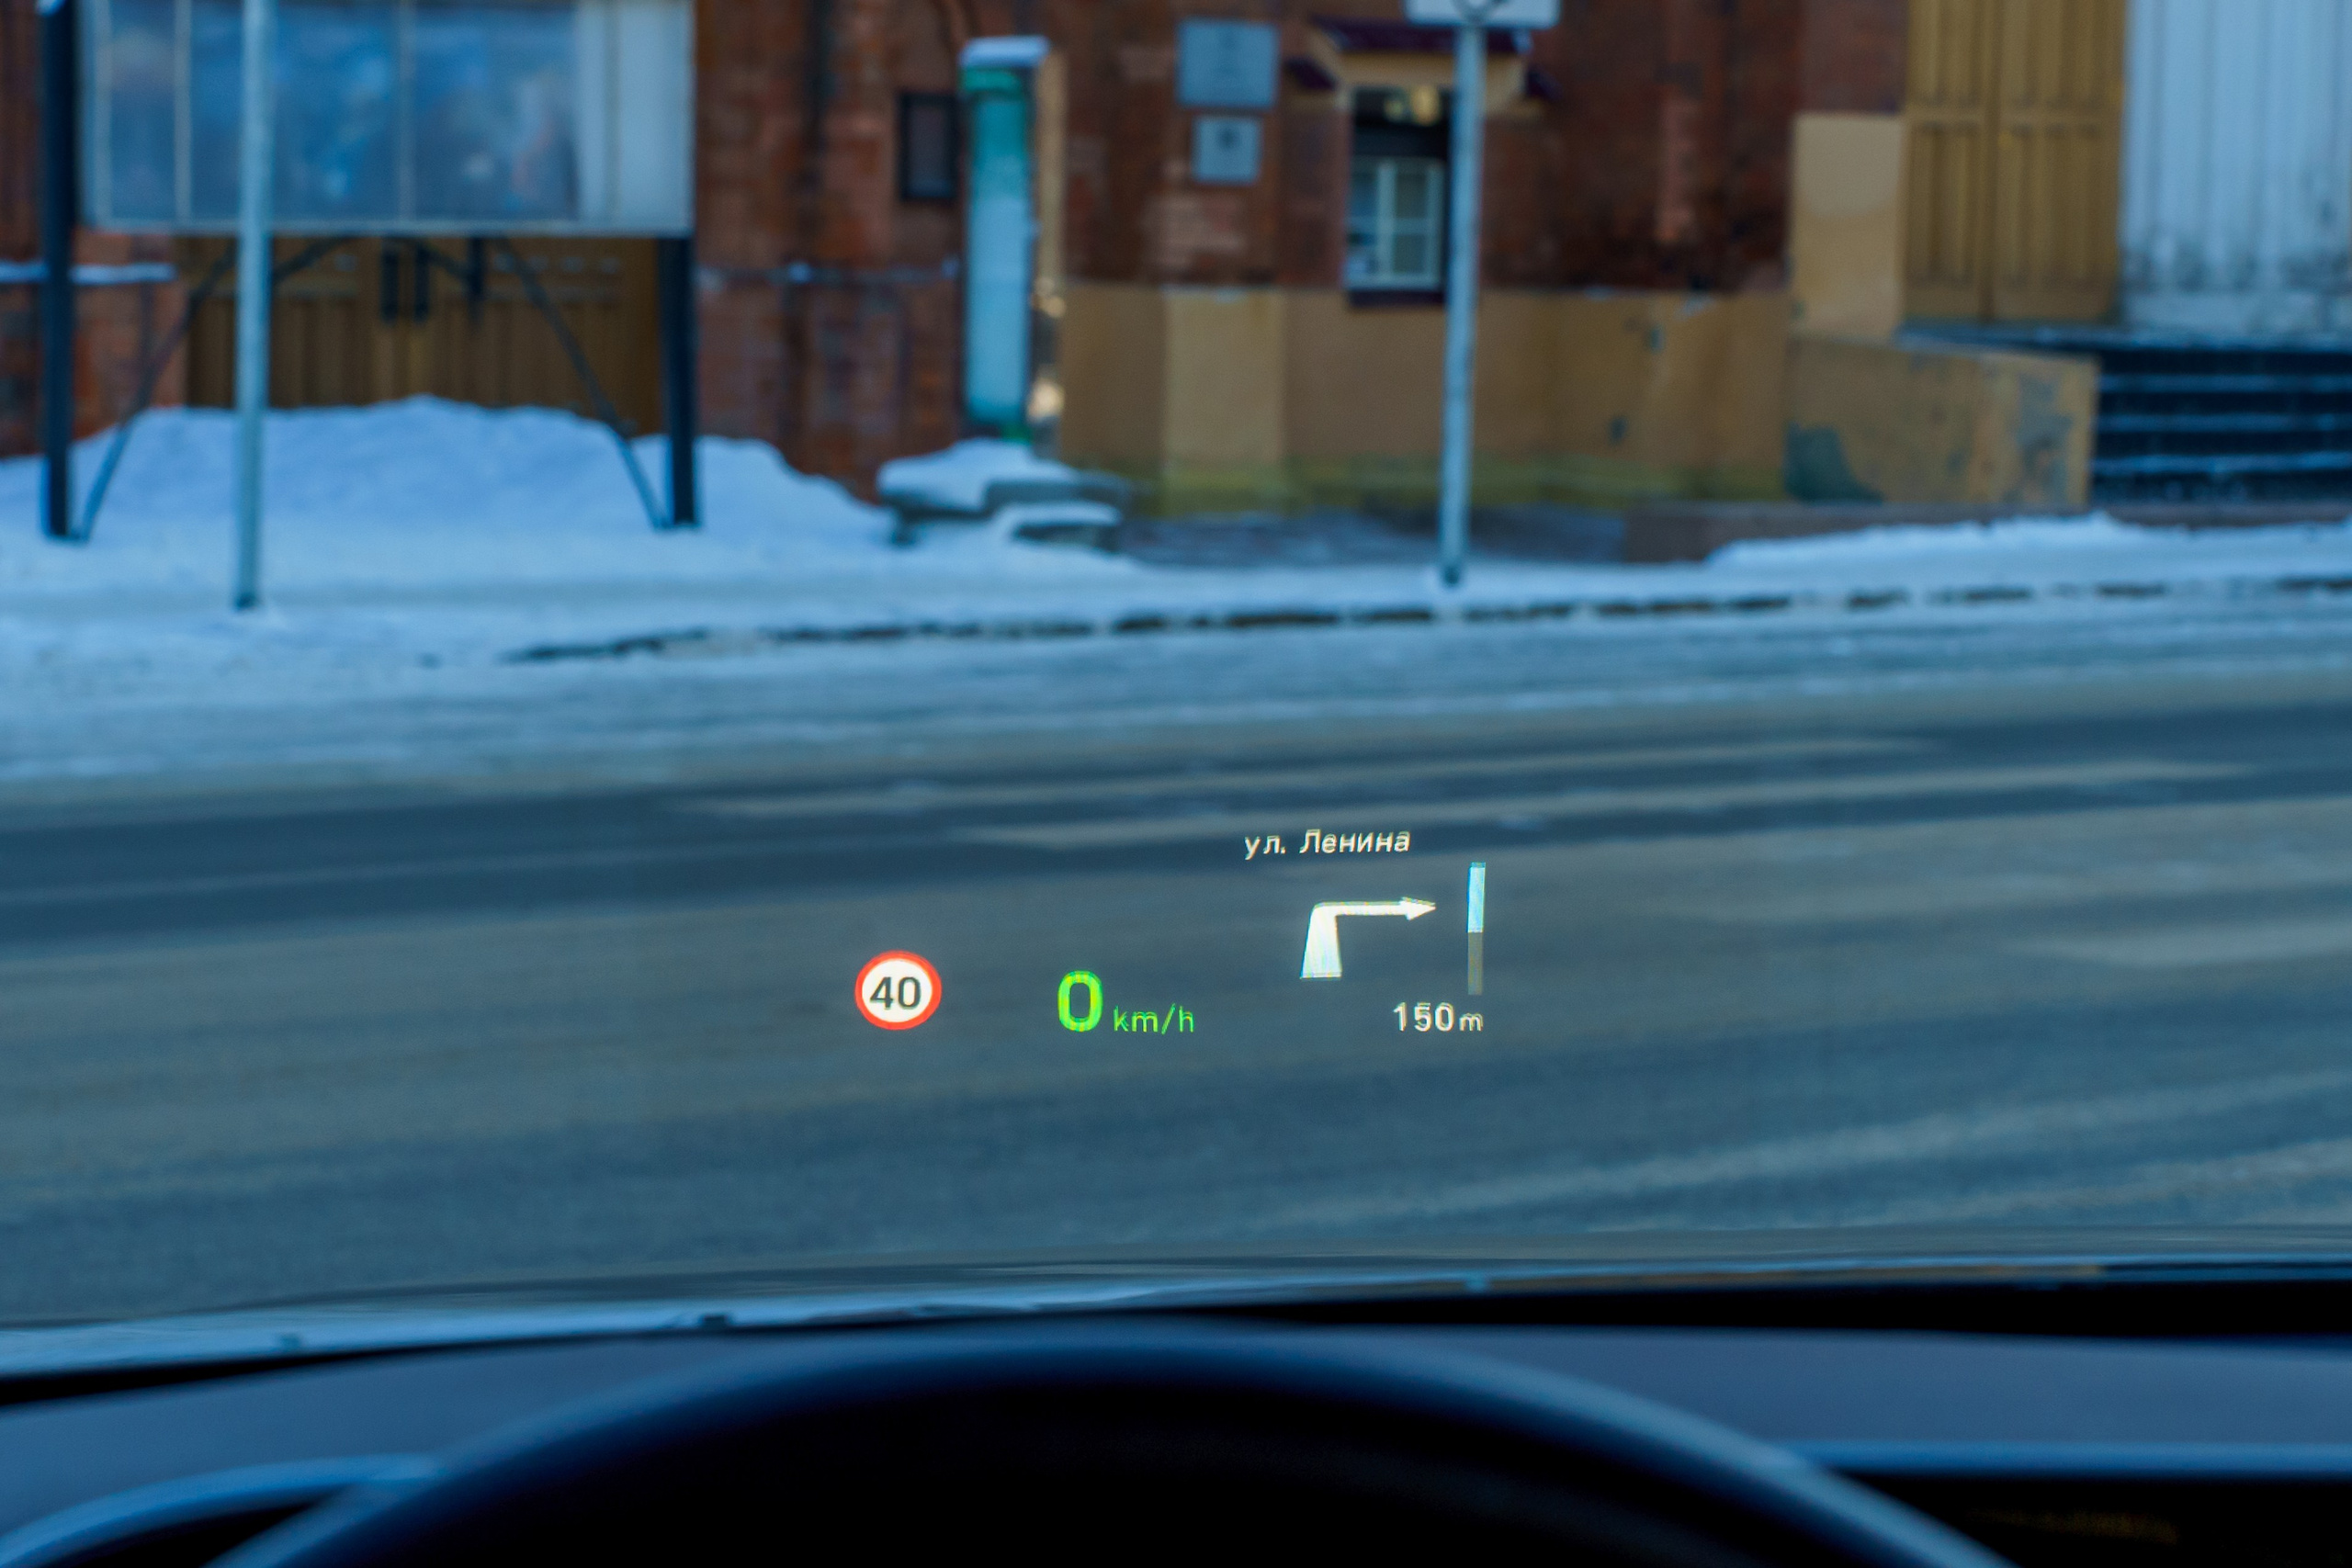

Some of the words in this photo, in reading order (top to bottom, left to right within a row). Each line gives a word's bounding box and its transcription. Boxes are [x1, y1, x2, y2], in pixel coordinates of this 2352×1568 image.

[1244, 835, 1286, 861] ул.
[1299, 829, 1411, 854] Ленина
[869, 976, 922, 1010] 40
[1057, 970, 1103, 1032] 0
[1113, 1003, 1194, 1034] km/h
